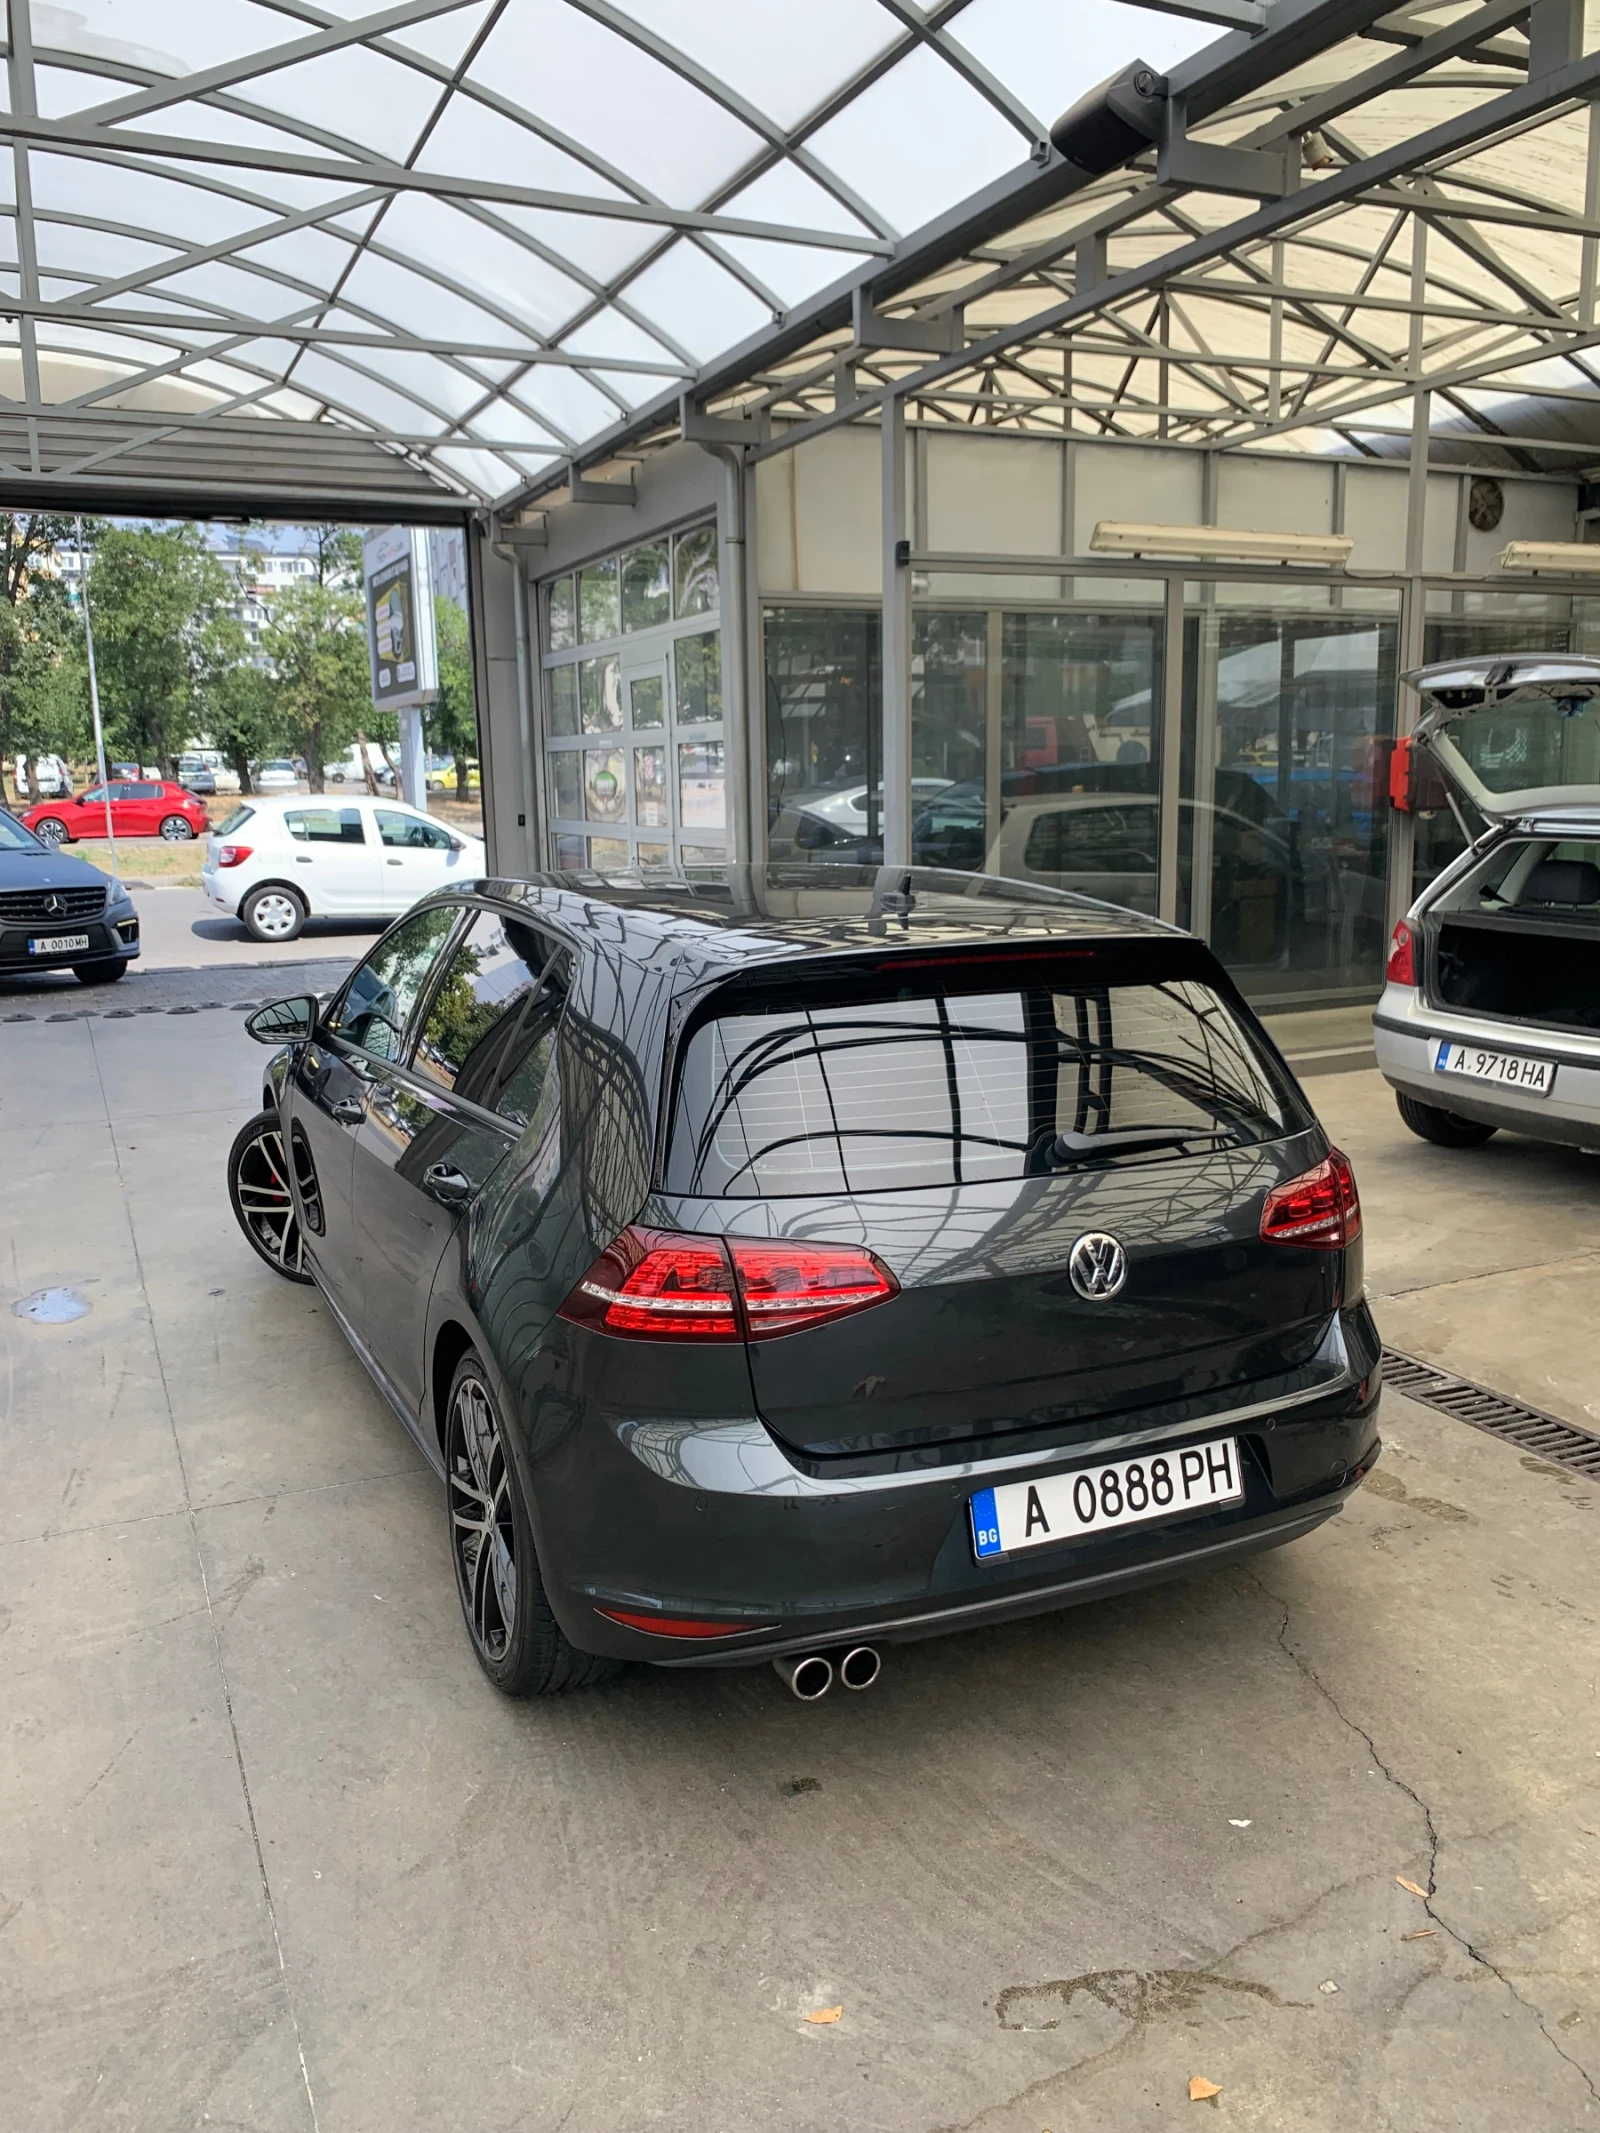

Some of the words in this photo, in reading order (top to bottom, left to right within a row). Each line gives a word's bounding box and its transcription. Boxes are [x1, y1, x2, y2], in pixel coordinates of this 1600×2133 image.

[1475, 1053, 1519, 1081] 9718
[1520, 1061, 1545, 1087] HA
[1025, 1485, 1051, 1538] A
[1073, 1458, 1174, 1524] 0888
[1179, 1443, 1233, 1500] PH
[979, 1528, 998, 1546] BG
